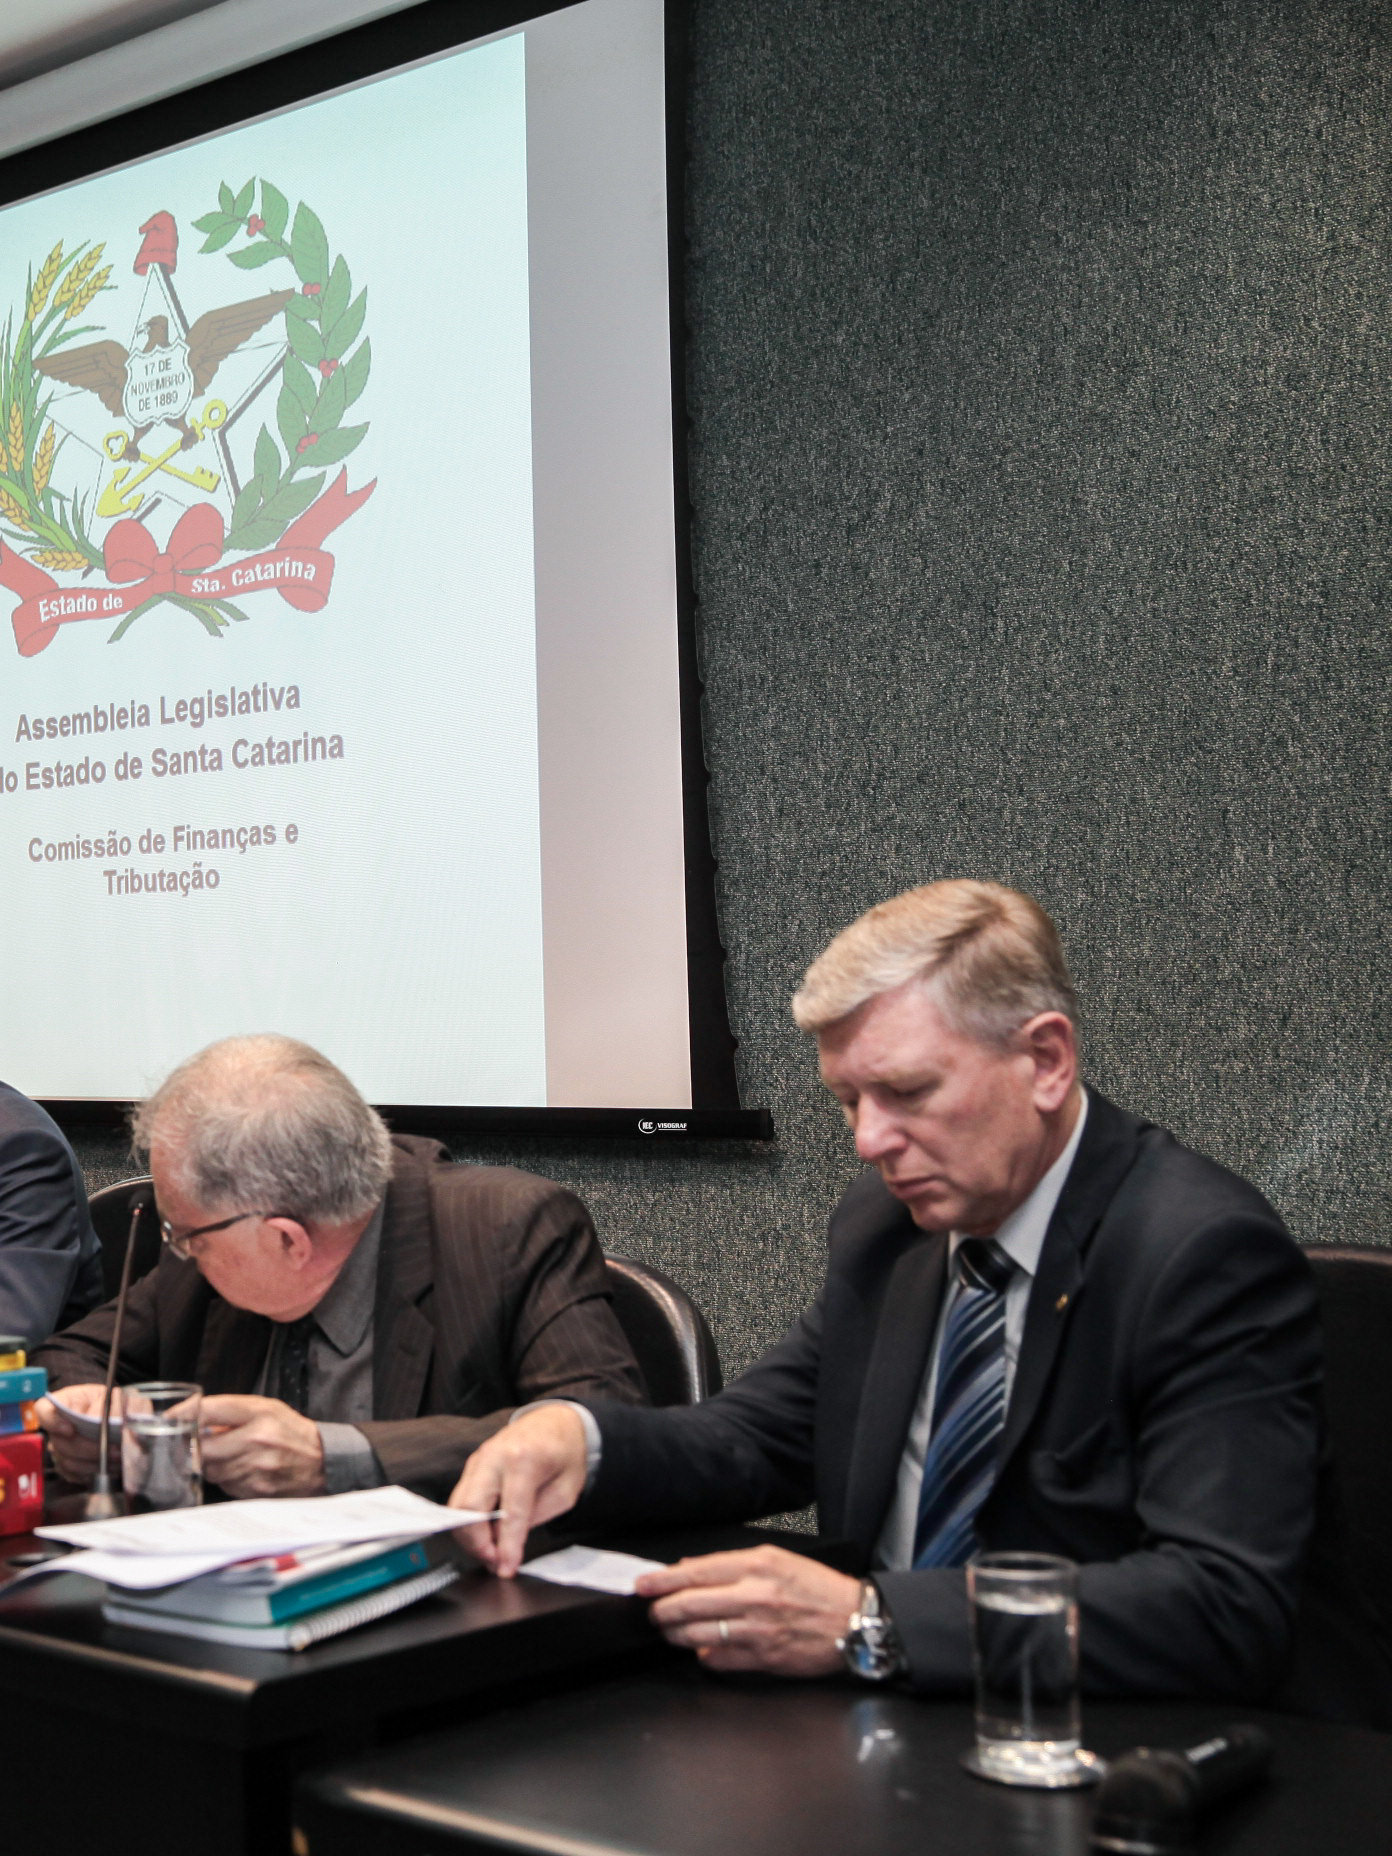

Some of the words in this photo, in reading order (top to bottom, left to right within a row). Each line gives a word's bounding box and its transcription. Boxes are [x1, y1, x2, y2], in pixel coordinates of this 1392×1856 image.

[130, 371, 186, 397] NOVEMBRO
[144, 362, 156, 377] 17
[158, 357, 172, 373] DE
[138, 397, 151, 412] DE
[154, 390, 179, 408] 1889
[191, 577, 226, 593] Sta.
[231, 557, 316, 587] Catarina
[39, 594, 98, 623] Estado
[102, 593, 123, 611] de
[15, 699, 150, 743] Assembleia
[159, 682, 301, 729] Legislativa
[25, 756, 107, 791] Estado
[114, 751, 143, 781] de
[151, 743, 223, 778] Santa
[231, 731, 345, 769] Catarina
[28, 830, 132, 863] Comissão
[138, 828, 166, 855] de
[173, 820, 277, 854] Finanças
[285, 822, 299, 844] e
[103, 861, 220, 897] Tributação
